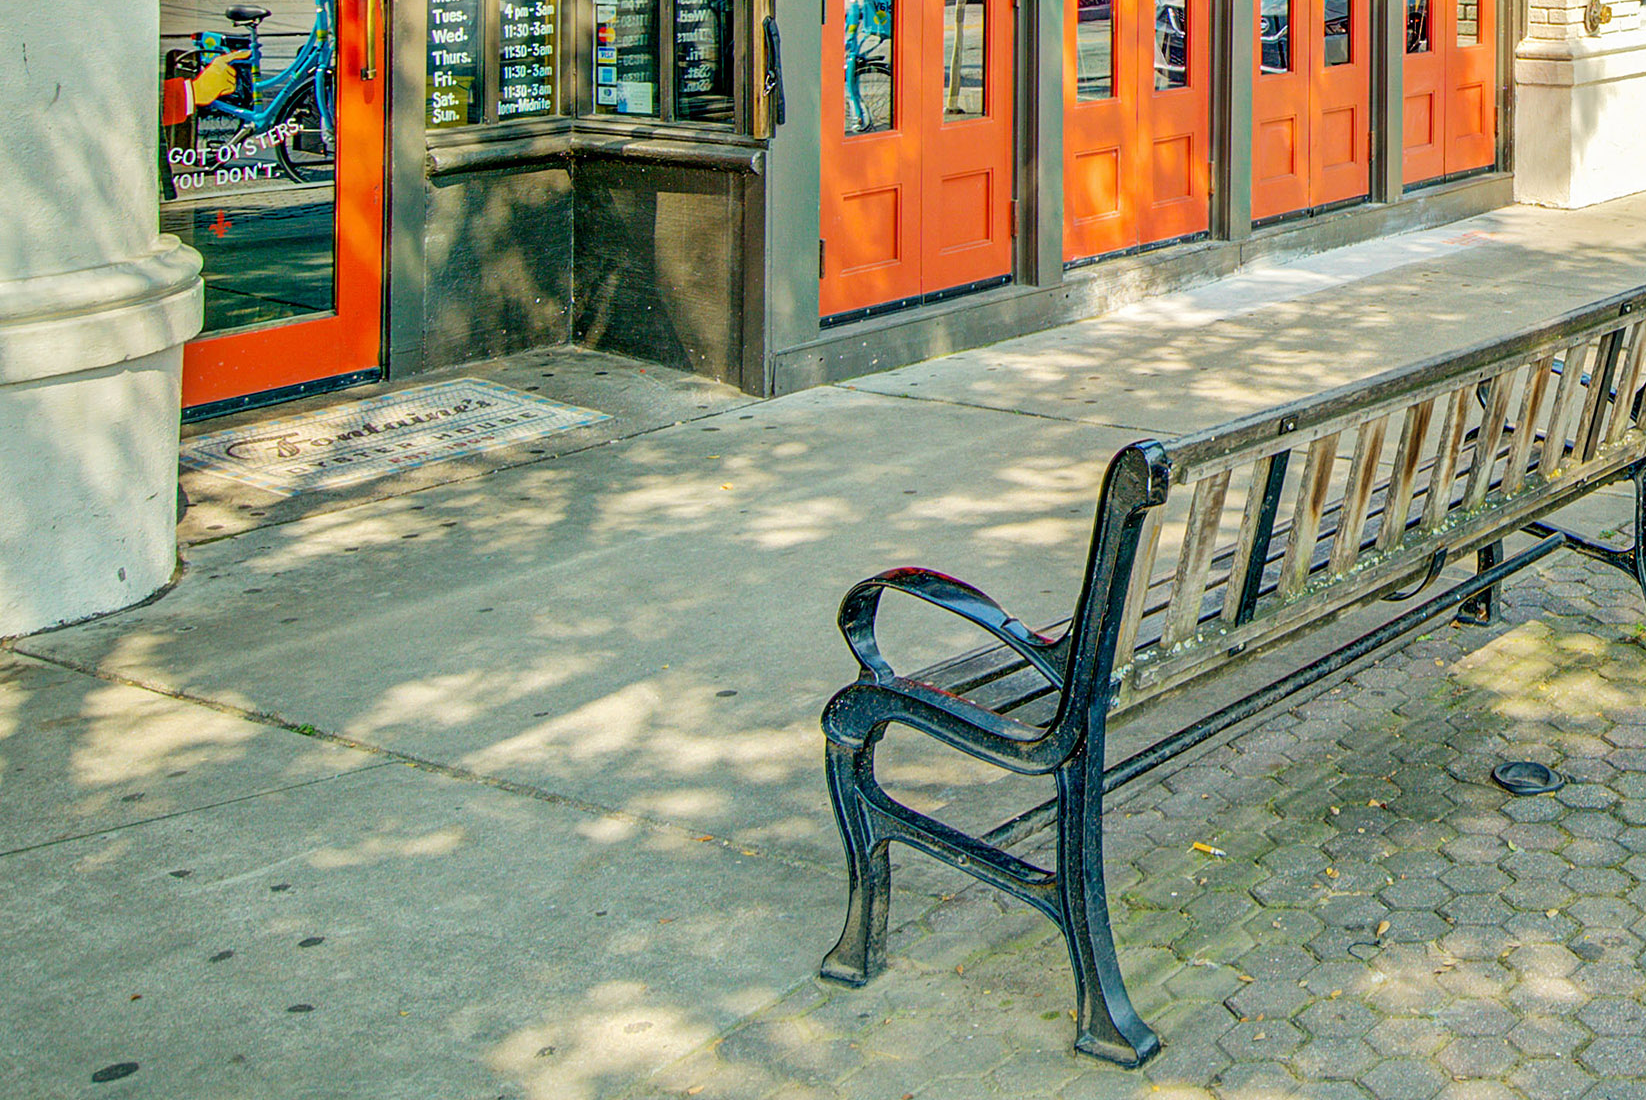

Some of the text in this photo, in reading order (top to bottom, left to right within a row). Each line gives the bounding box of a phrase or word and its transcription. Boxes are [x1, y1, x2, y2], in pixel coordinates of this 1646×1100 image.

[432, 9, 468, 24] Tues.
[432, 27, 468, 44] Wed.
[432, 50, 472, 66] Thurs.
[433, 71, 457, 87] Fri.
[432, 92, 459, 108] Sat.
[432, 108, 460, 123] Sun.
[168, 147, 211, 166] GOT
[215, 162, 280, 185] DON'T.
[225, 397, 498, 460] Fontaine's
[285, 412, 539, 475] OYSTER HOUSE
